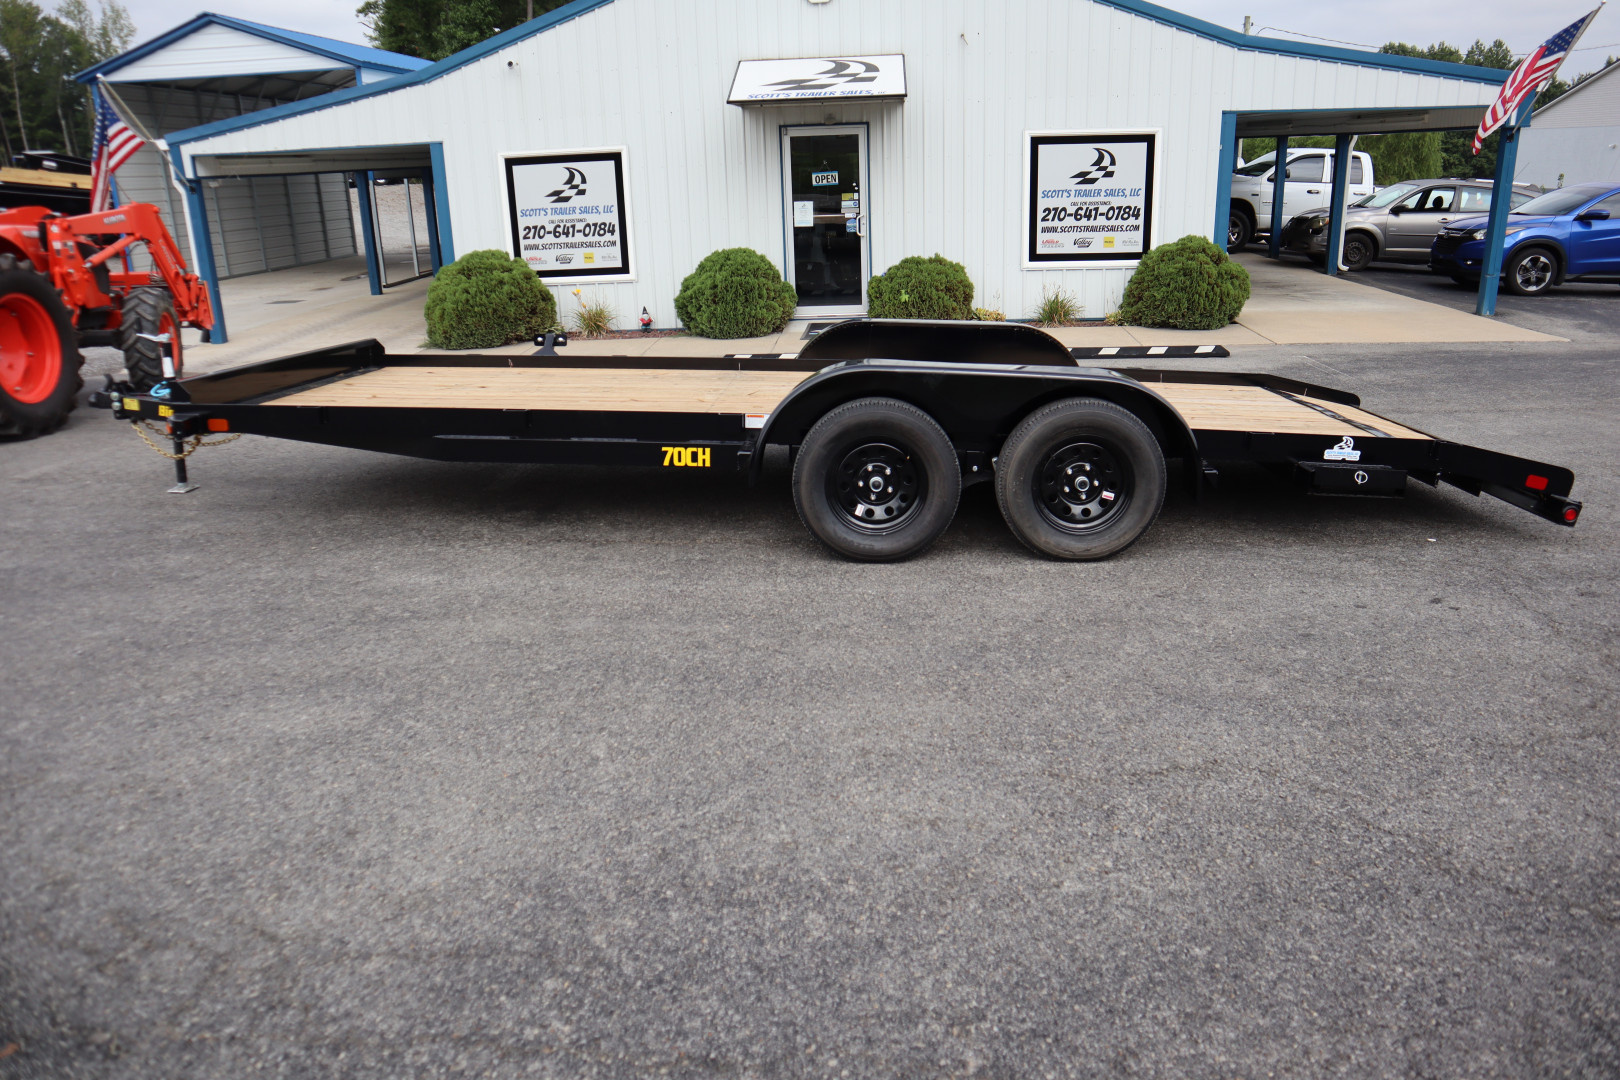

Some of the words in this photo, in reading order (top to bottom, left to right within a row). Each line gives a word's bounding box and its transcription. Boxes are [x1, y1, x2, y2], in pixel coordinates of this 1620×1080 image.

[815, 174, 836, 184] OPEN
[1041, 189, 1072, 199] SCOTT'S
[1073, 188, 1102, 198] TRAILER
[1103, 188, 1128, 198] SALES,
[1129, 188, 1142, 197] LLC
[520, 207, 549, 217] SCOTT'S
[550, 206, 577, 216] TRAILER
[579, 205, 601, 215] SALES,
[603, 204, 615, 214] LLC
[1040, 205, 1141, 222] 270-641-0784
[522, 222, 616, 240] 270-641-0784
[1041, 224, 1140, 234] WWW.SCOTTSTRAILERSALES.COM
[523, 240, 617, 251] WWW.SCOTTSTRAILERSALES.COM
[661, 446, 711, 467] 70CH
